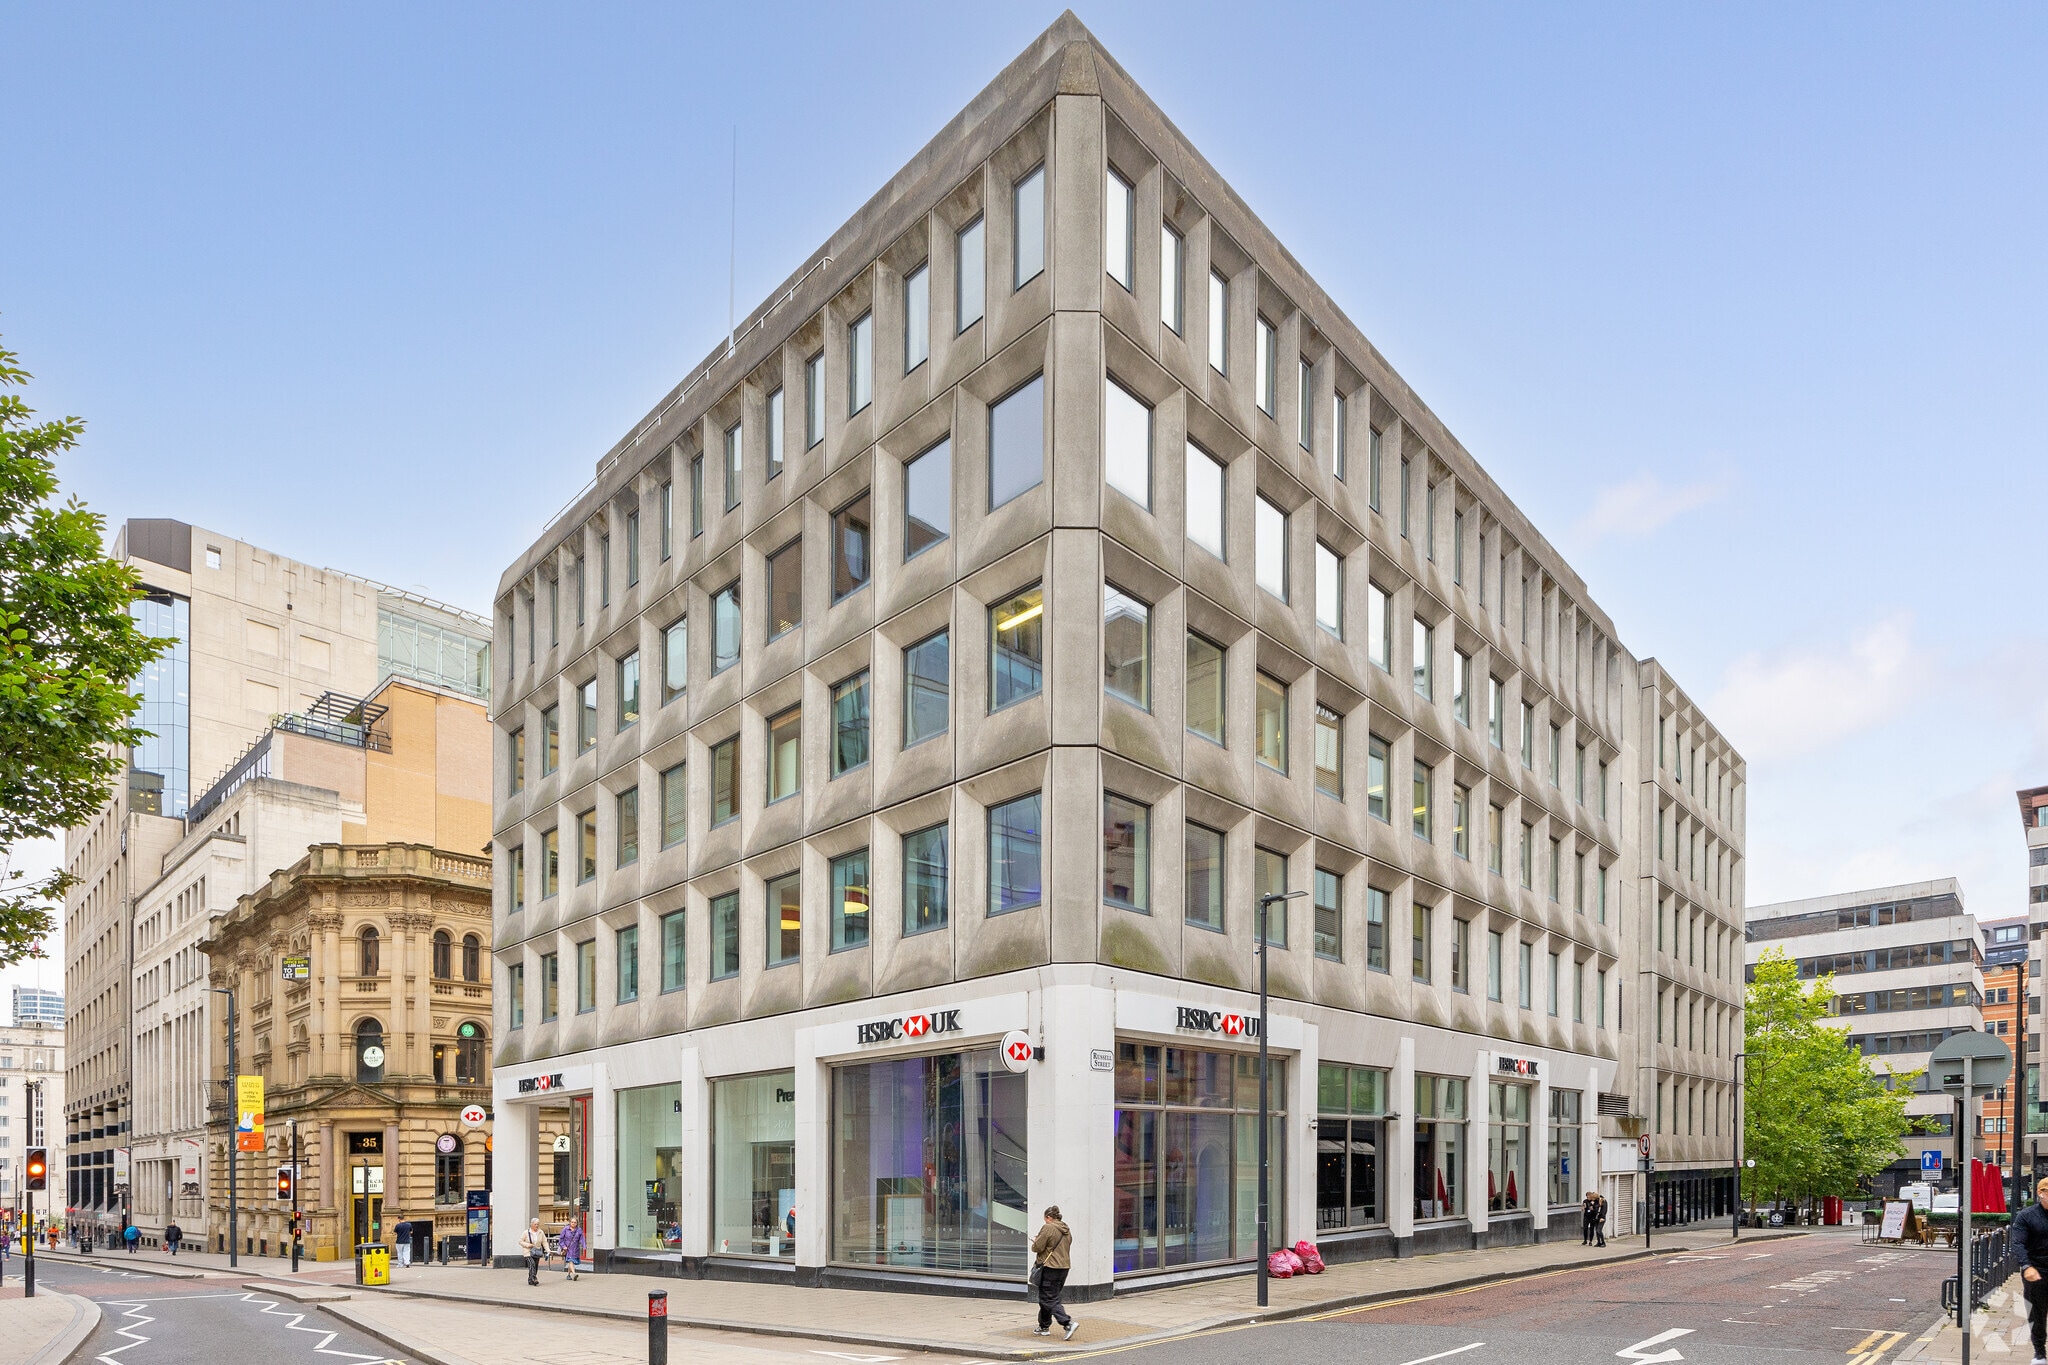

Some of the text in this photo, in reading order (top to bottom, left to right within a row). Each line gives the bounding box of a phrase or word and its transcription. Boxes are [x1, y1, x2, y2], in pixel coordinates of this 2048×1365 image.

[857, 1009, 963, 1044] HSBC UK
[1176, 1006, 1268, 1038] HSBC U
[1498, 1056, 1539, 1075] HSBC UK
[518, 1073, 564, 1093] HSBC UK
[362, 1137, 377, 1148] 35
